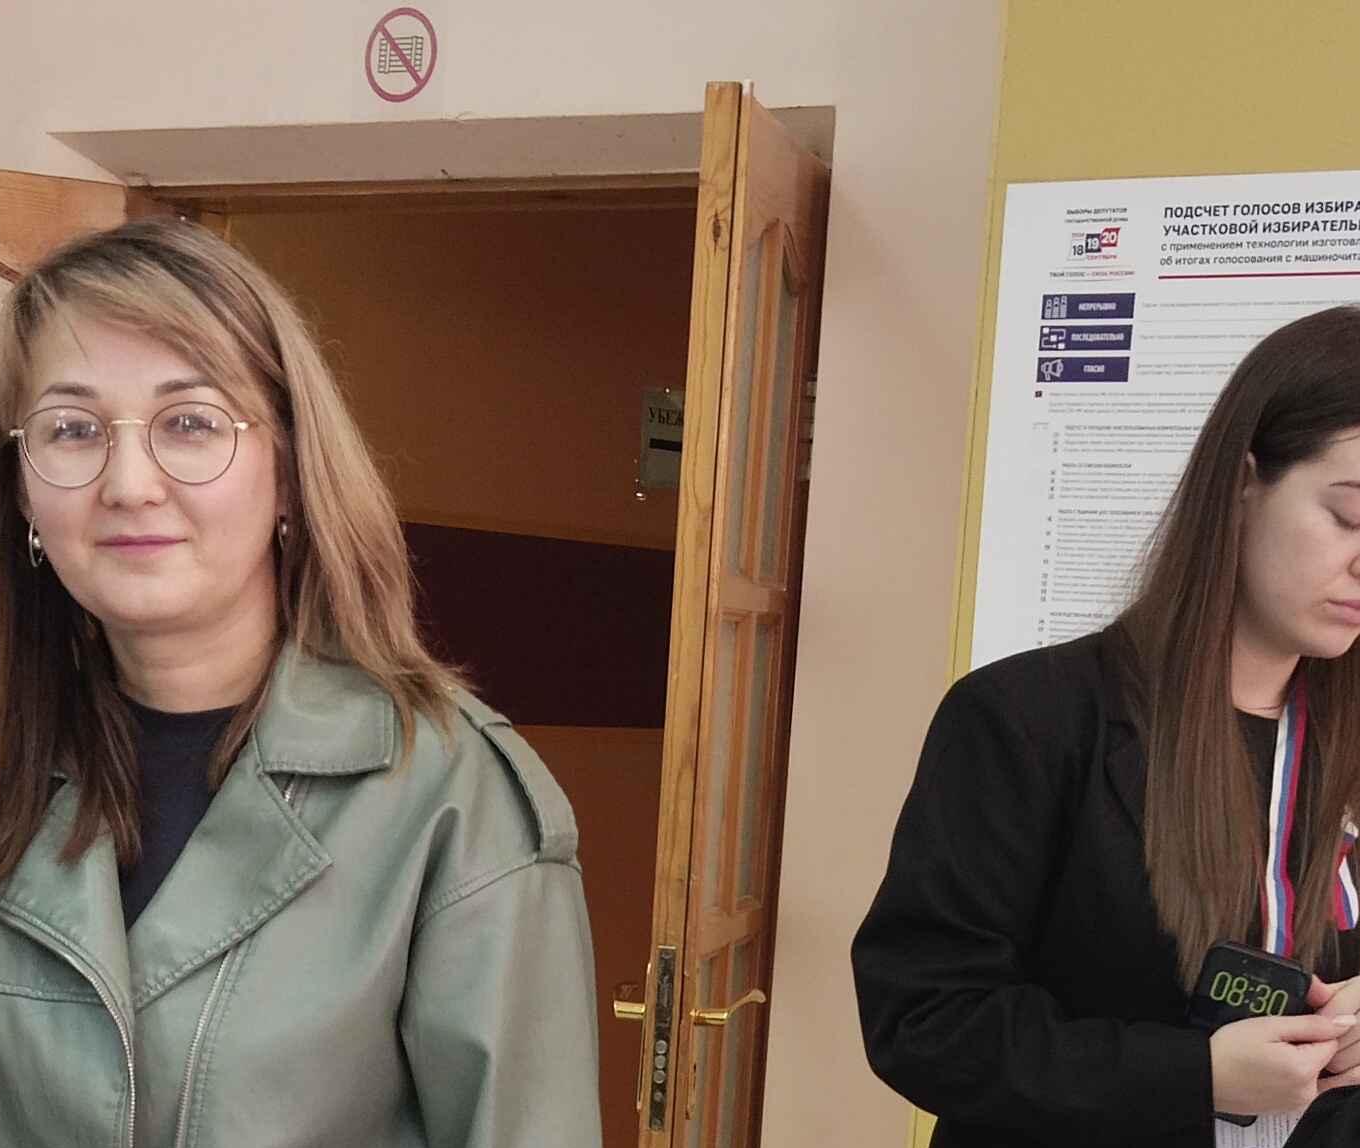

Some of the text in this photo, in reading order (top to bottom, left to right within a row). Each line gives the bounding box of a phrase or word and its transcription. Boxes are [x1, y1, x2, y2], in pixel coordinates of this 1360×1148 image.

[1163, 204, 1230, 220] ПОДСЧЕТ
[1232, 202, 1302, 217] ГОЛОСОВ
[1162, 219, 1259, 237] УЧАСТКОВОЙ
[1072, 231, 1118, 256] 18 19 20
[1160, 243, 1168, 251] с
[1169, 241, 1243, 253] применением
[1246, 239, 1309, 249] технологии
[1159, 255, 1173, 266] об
[1174, 255, 1211, 266] итогах
[1213, 254, 1283, 265] голосования
[1285, 254, 1292, 263] с
[1209, 971, 1289, 1017] 08:30
